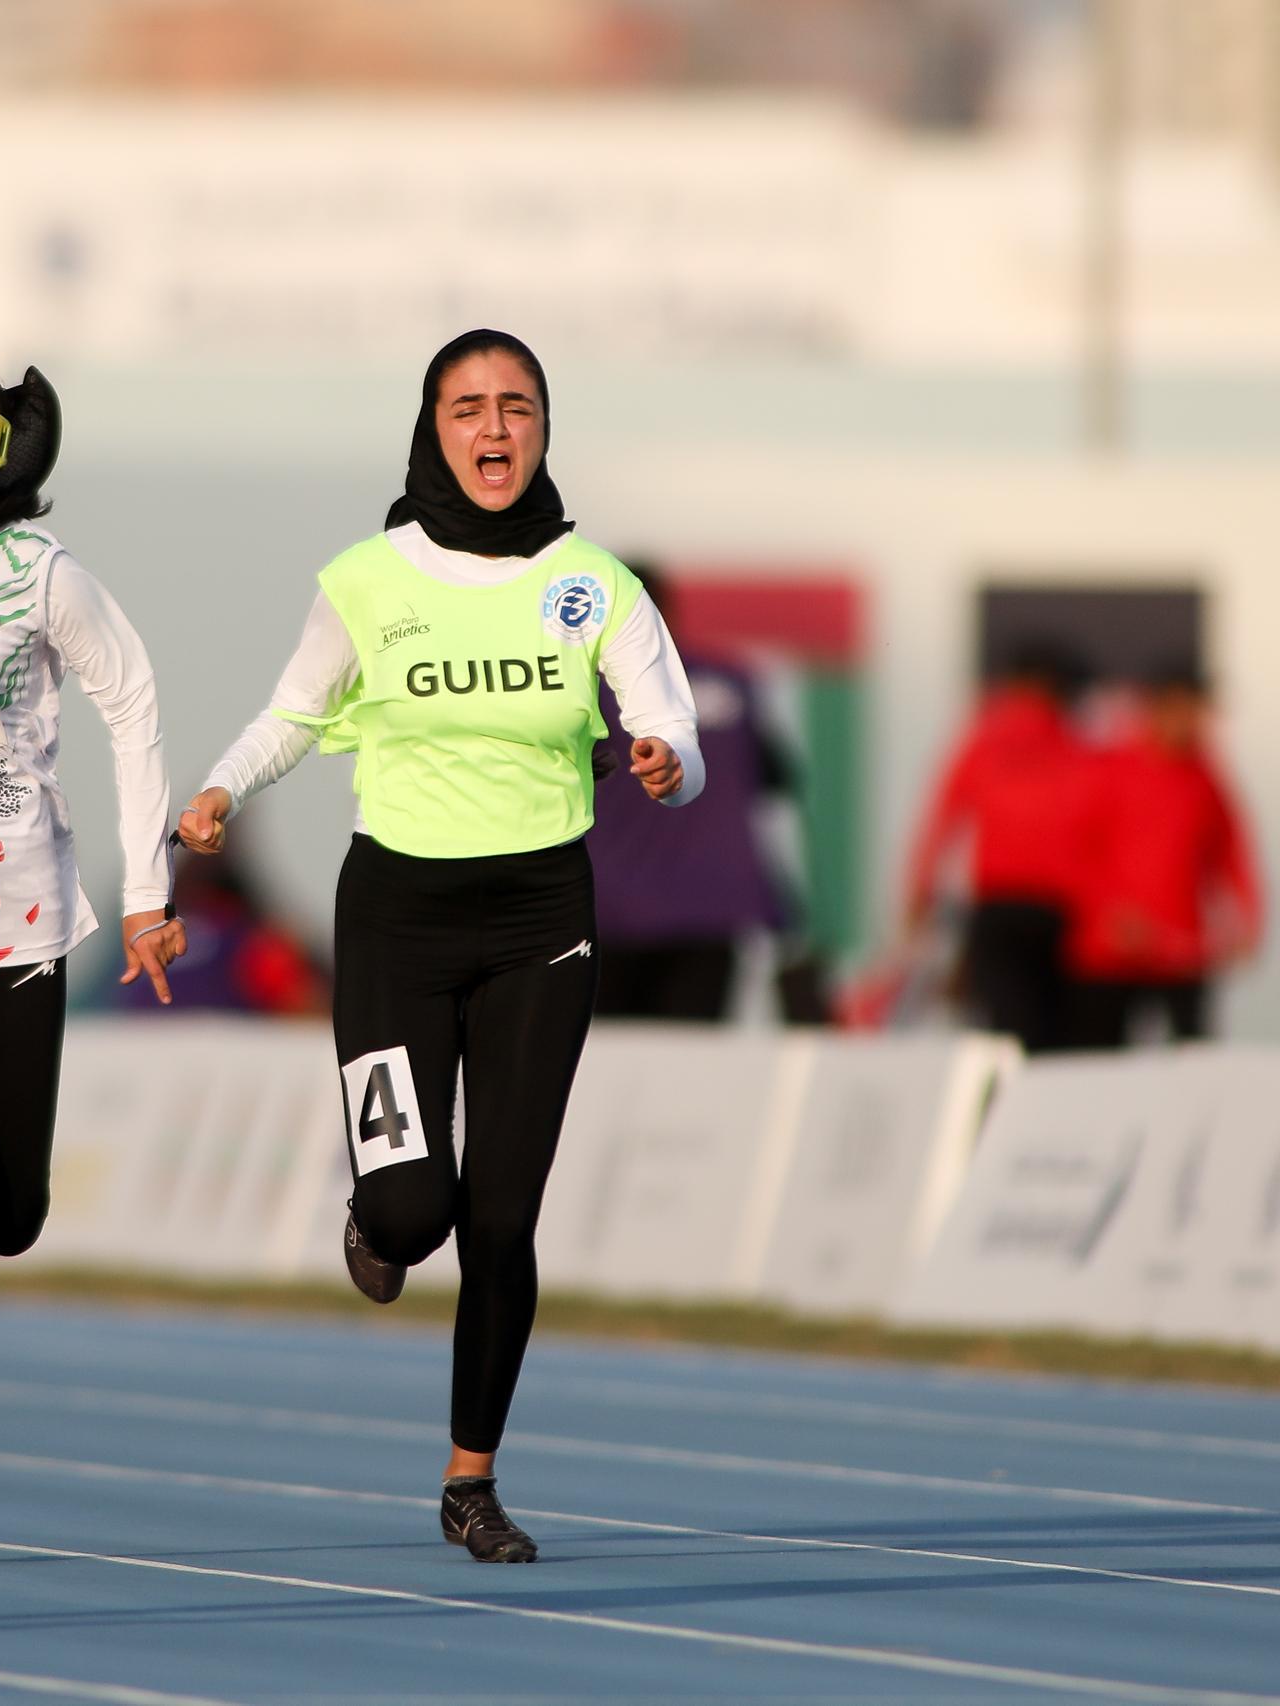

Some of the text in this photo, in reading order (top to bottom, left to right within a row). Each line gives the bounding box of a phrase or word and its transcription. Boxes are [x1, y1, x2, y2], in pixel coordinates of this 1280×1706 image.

[383, 623, 431, 646] Athletics
[406, 654, 565, 698] GUIDE
[358, 1061, 411, 1151] 4
